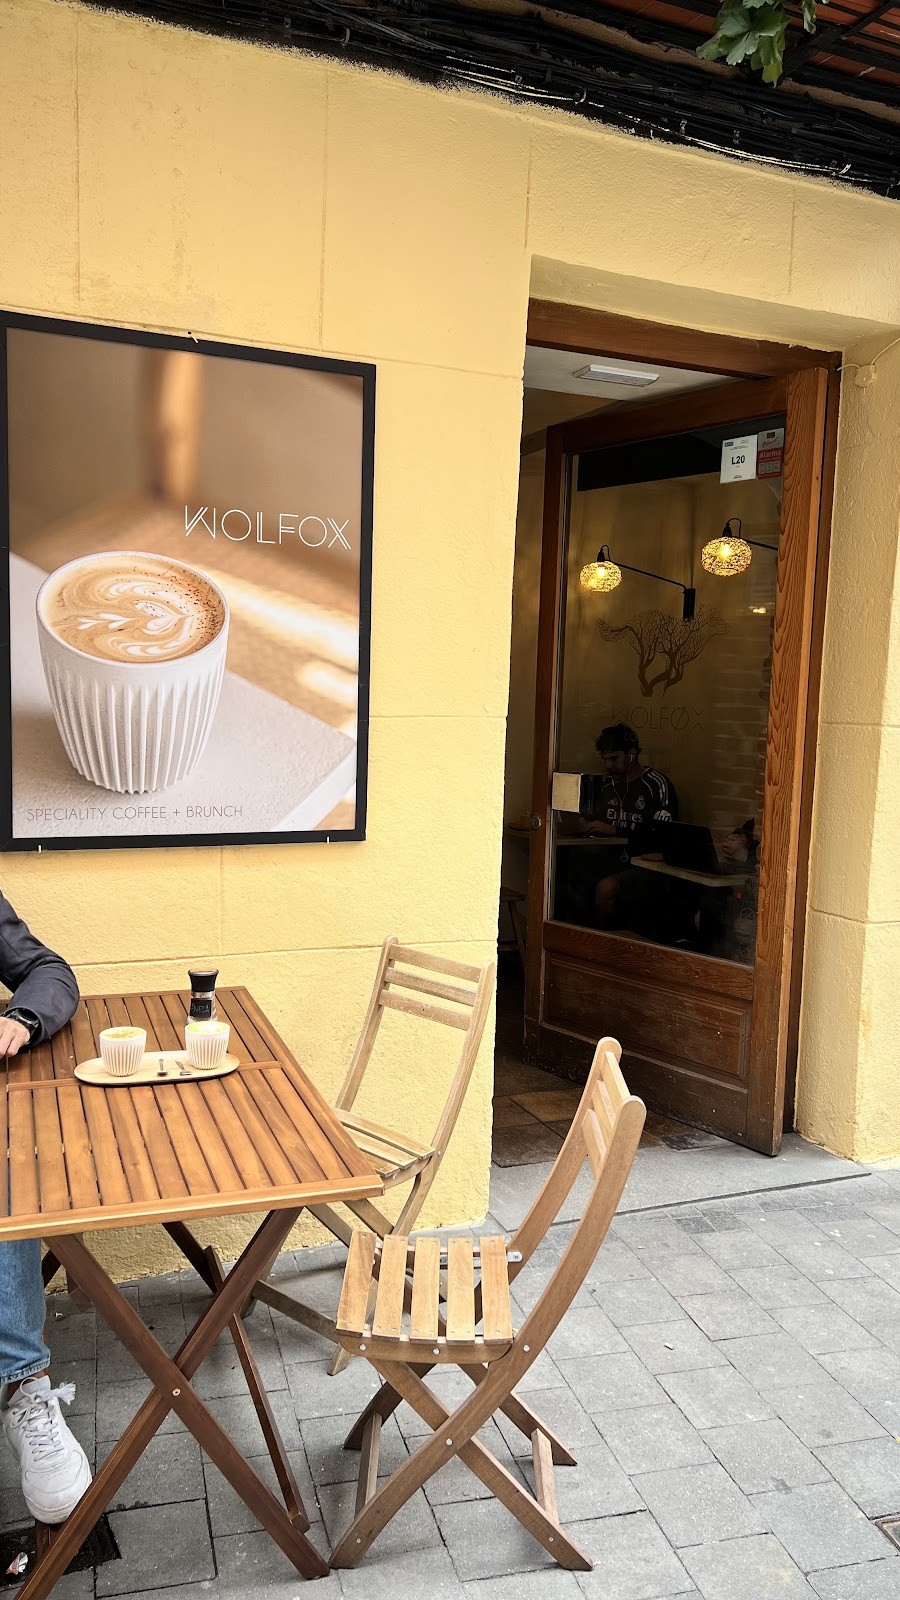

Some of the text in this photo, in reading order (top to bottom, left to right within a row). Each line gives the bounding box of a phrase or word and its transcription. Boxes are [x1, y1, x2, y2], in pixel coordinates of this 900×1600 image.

[731, 455, 746, 465] L20
[184, 505, 352, 550] WOLFOX
[26, 805, 243, 821] SPECIALITY COFFEE + BRUNCH
